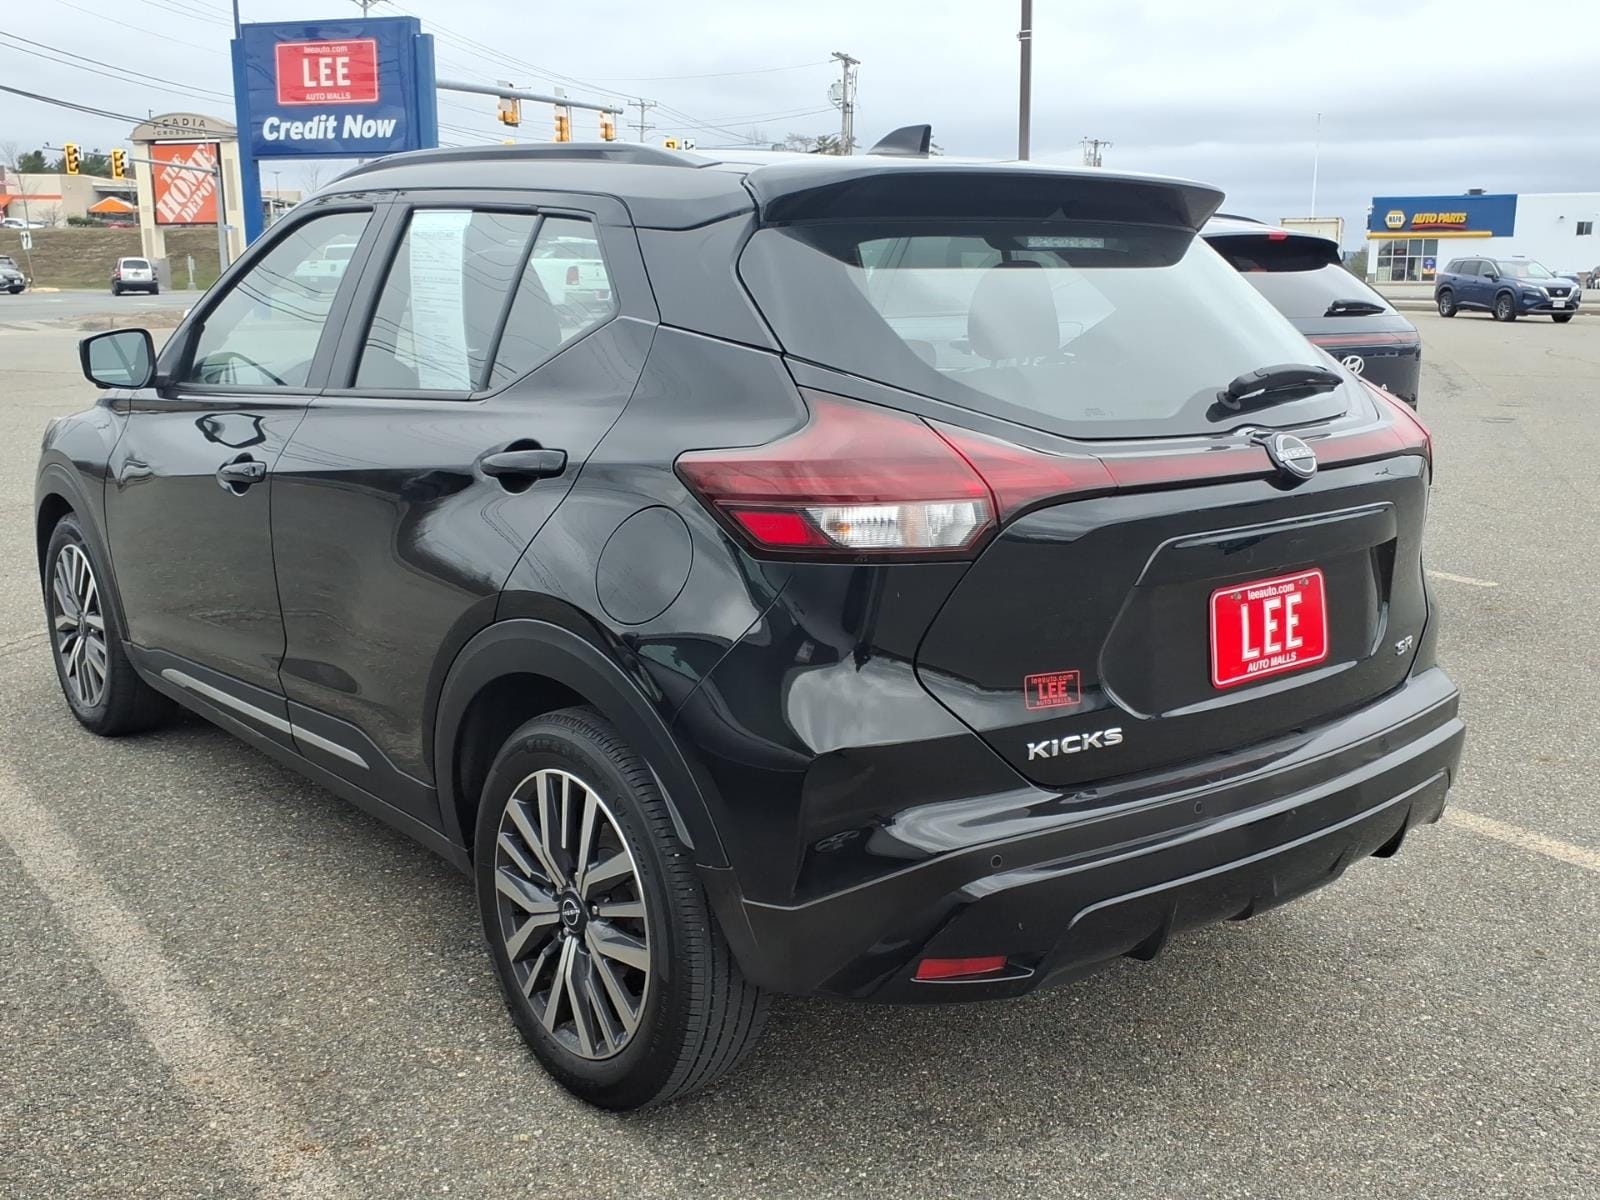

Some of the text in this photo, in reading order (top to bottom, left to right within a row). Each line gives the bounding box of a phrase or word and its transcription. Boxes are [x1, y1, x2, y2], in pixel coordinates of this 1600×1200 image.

[303, 45, 348, 54] leeauto.com
[302, 57, 351, 88] LEE
[326, 92, 351, 100] MALLS
[262, 114, 396, 140] Credit Now
[160, 154, 185, 184] THE
[156, 144, 216, 222] HOME
[1411, 212, 1467, 224] AUTO PARTS
[1247, 583, 1295, 600] leeauto.com
[1240, 591, 1303, 662] LEE
[1395, 635, 1413, 655] SR
[1247, 651, 1297, 673] AUTO MALLS
[1030, 674, 1074, 684] leeauto.com
[1038, 681, 1067, 700] LEE
[1036, 698, 1052, 706] AUTO
[1026, 727, 1123, 760] KICKS
